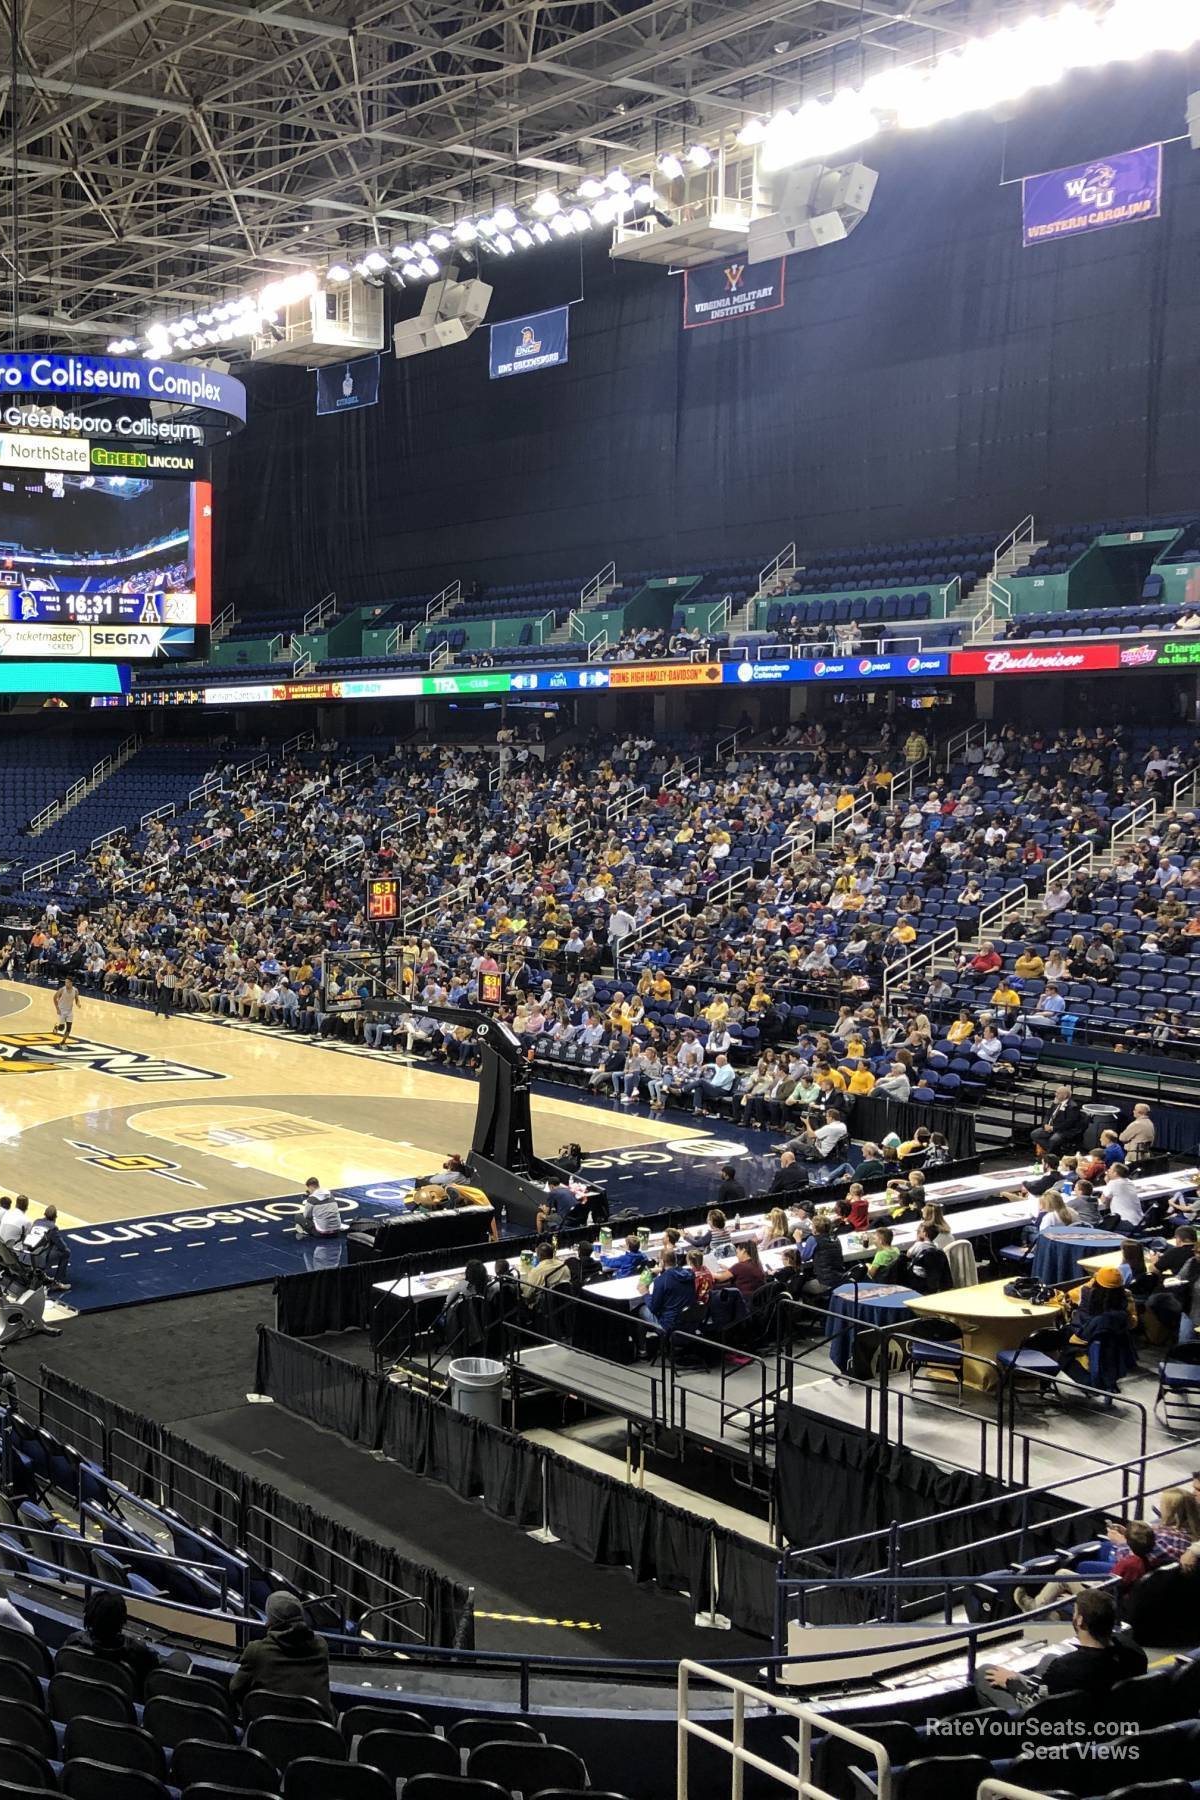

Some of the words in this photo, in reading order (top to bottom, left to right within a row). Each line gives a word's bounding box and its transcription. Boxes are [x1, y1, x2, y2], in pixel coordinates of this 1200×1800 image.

[1028, 216, 1088, 238] WESTERN
[1088, 200, 1151, 225] CAROLINA
[695, 297, 731, 312] VIRGINIA
[732, 286, 774, 305] MILITARY
[711, 301, 756, 319] INSTITUTE
[31, 359, 141, 389] Coliseum
[149, 367, 221, 402] Complex
[3, 407, 112, 433] Greensboro
[116, 416, 200, 441] Coliseum
[11, 444, 87, 463] NorthState
[91, 448, 147, 468] GREEN
[147, 454, 194, 470] LINCOLN
[66, 594, 112, 614] 16:31
[16, 631, 77, 642] ticketmaster
[93, 633, 150, 645] SEGRA
[826, 665, 844, 673] pepsi
[871, 662, 891, 672] pepsi
[921, 660, 940, 669] pepsi
[984, 651, 1085, 672] Budweiser
[432, 678, 460, 692] TFA
[610, 672, 629, 683] RIDING
[631, 671, 644, 682] HIGH
[373, 882, 396, 895] 16:31
[373, 895, 393, 915] 30
[485, 987, 497, 999] 30
